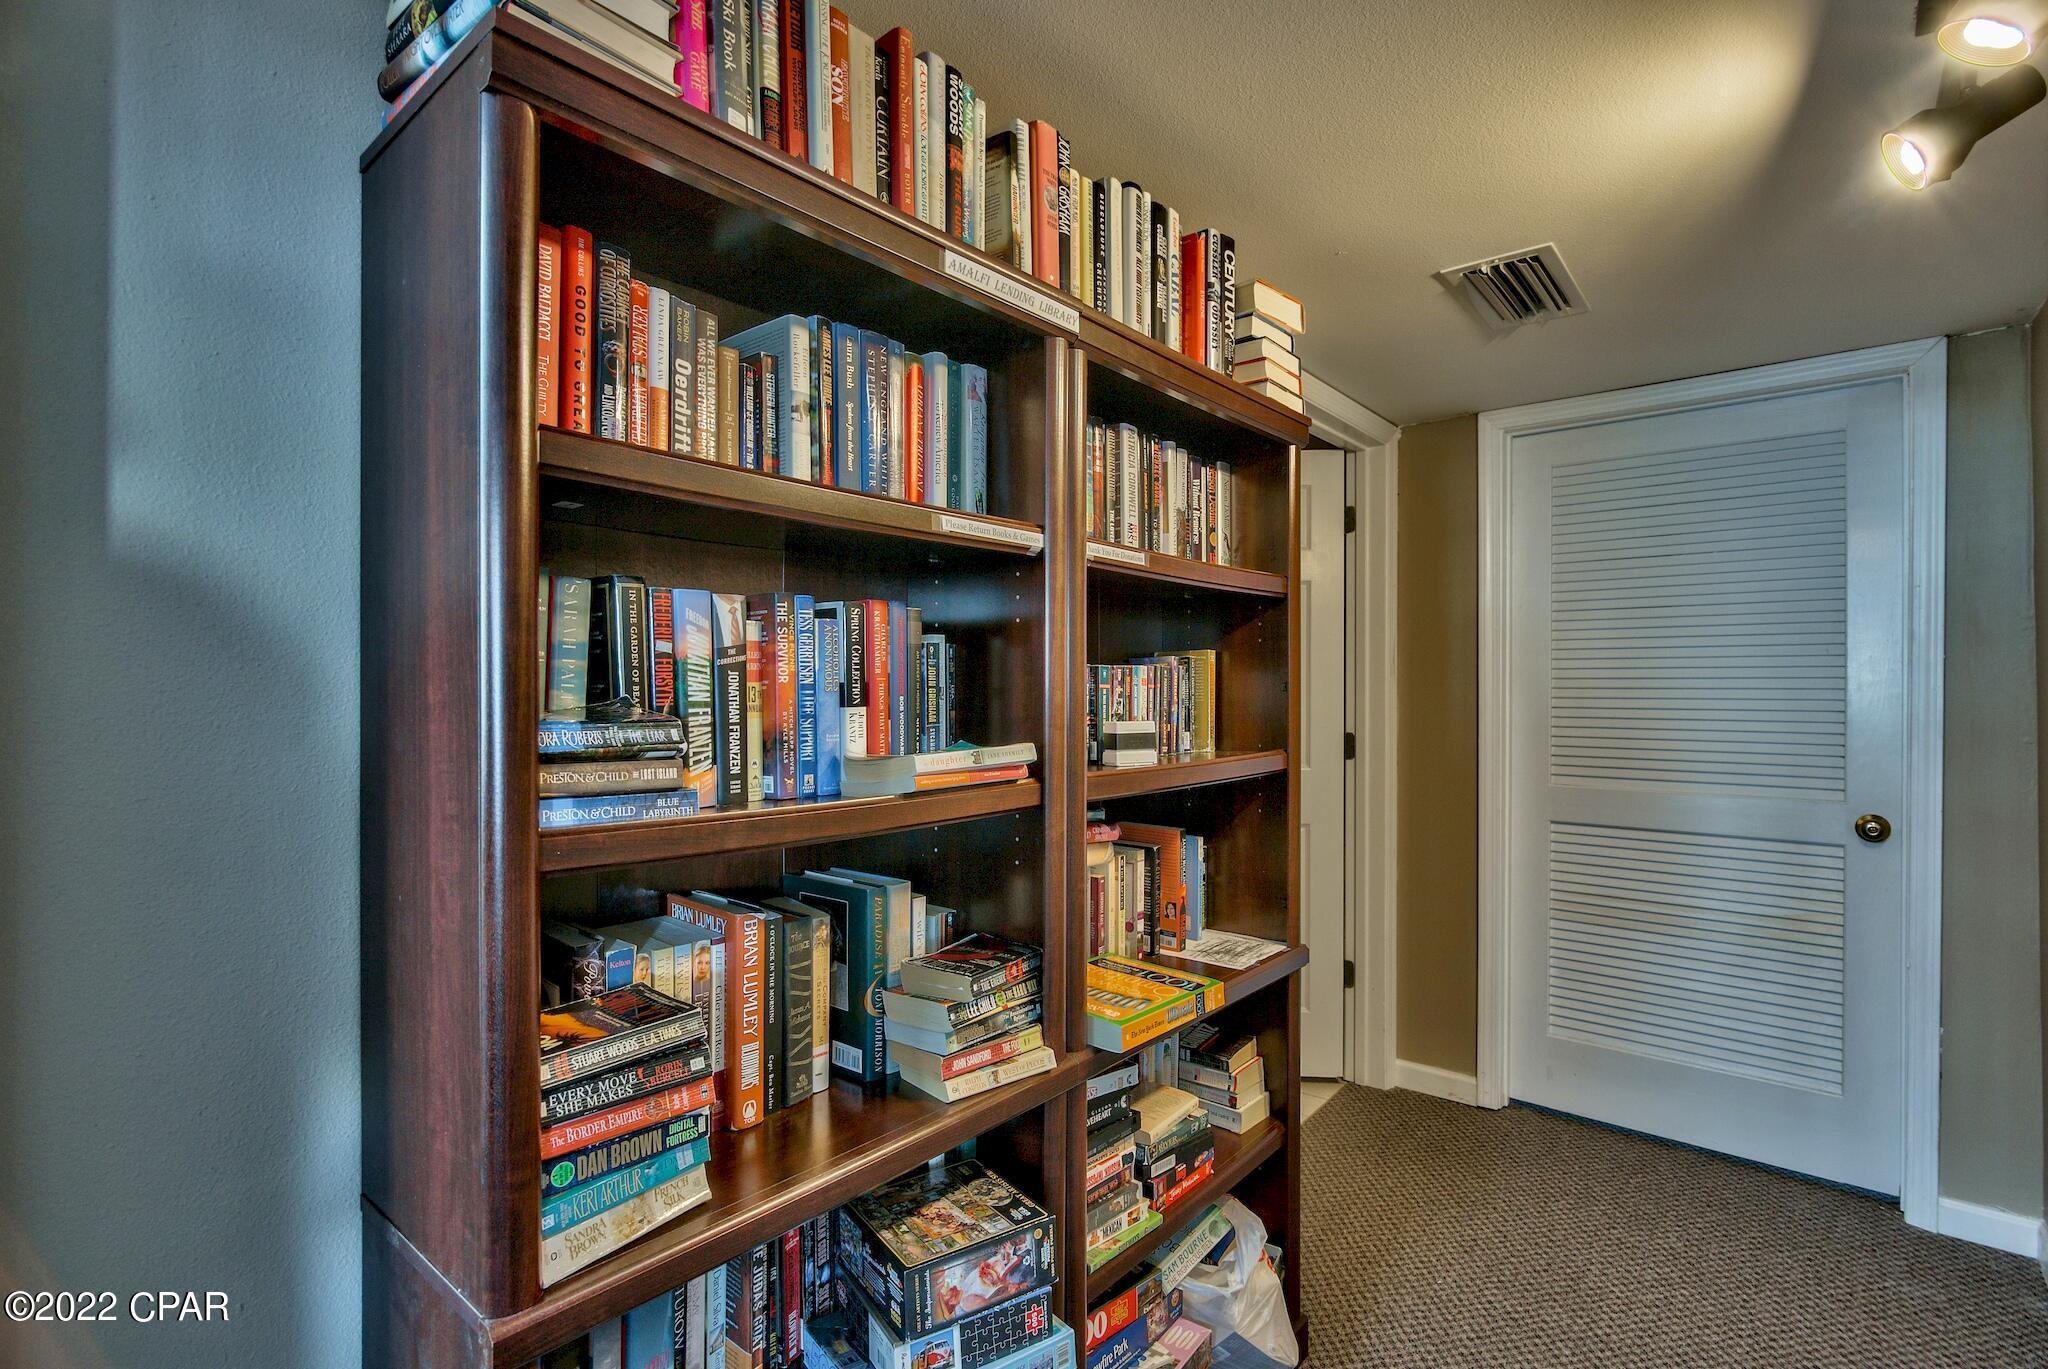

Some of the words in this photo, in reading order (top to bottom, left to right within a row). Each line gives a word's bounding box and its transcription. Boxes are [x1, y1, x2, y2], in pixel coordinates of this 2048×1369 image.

[722, 0, 735, 24] Ski
[723, 27, 736, 72] Book
[900, 35, 910, 90] Eminently
[690, 51, 702, 92] GAME
[832, 64, 844, 107] SON
[875, 56, 883, 81] Korda
[901, 93, 911, 138] Suitable
[949, 74, 958, 136] WOODS
[876, 95, 890, 182] CURTAIN
[1059, 136, 1069, 169] JOHN
[1059, 186, 1070, 235] GRISHAM
[577, 249, 585, 277] COLLINS
[948, 258, 991, 287] AMALFI
[994, 279, 1035, 308] LENDING
[1038, 300, 1079, 327] LIBRARY
[1224, 250, 1235, 341] CENTURY
[822, 326, 832, 358] JAMES
[1211, 305, 1219, 352] ODYSSEY
[538, 355, 550, 376] THE
[793, 334, 802, 388] Rockefeller
[823, 359, 832, 376] LEE
[846, 336, 854, 362] Laura
[767, 373, 776, 407] STEPHEN
[823, 376, 832, 406] BURKE
[846, 365, 854, 389] Bush
[538, 377, 549, 417] GUILTY
[674, 358, 692, 452] Oerdrift
[767, 408, 776, 438] HUNTER
[1128, 428, 1136, 469] PATRICIA
[880, 452, 888, 497] WHITE
[1128, 471, 1136, 520] CORNWELL
[1192, 478, 1200, 509] Without
[944, 518, 968, 533] Please
[968, 523, 991, 537] Return
[992, 527, 1013, 540] Books
[1012, 531, 1020, 541] &
[1019, 533, 1041, 546] Games
[1193, 510, 1201, 544] Remorse
[776, 601, 788, 622] THE
[798, 608, 813, 631] TESS
[851, 607, 861, 642] SPRING
[685, 625, 710, 703] JONATHAN
[777, 626, 788, 683] SURVIVOR
[798, 633, 814, 685] GERRITSEN
[823, 624, 832, 692] ANONYMOUS
[851, 645, 862, 705] COLLECTION
[727, 670, 741, 723] JONATHAN
[800, 690, 814, 715] LIFE
[687, 707, 712, 777] FRANZEN
[800, 718, 815, 762] SUPPORT
[849, 712, 858, 744] KRANTZ
[728, 725, 741, 774] FRANZEN
[542, 808, 589, 823] PRESTON
[590, 807, 602, 821] &
[602, 805, 636, 818] CHILD
[643, 806, 694, 819] LABYRINTH
[657, 797, 679, 807] BLUE
[671, 902, 695, 923] BRIAN
[695, 909, 728, 935] LUMLEY
[743, 918, 758, 969] BRIAN
[609, 957, 632, 970] Kelton
[743, 971, 759, 1036] LUMLEY
[967, 1002, 980, 1020] LEE
[979, 996, 996, 1016] CHILD
[874, 1017, 884, 1073] MORRISON
[951, 1057, 968, 1072] JOHN
[967, 1049, 992, 1068] SANDFORD
[654, 1058, 684, 1075] ROBIN
[741, 1041, 760, 1091] BLOODWARS
[549, 1081, 595, 1108] EVERY
[597, 1071, 638, 1092] MOVE
[556, 1099, 584, 1118] SHE
[587, 1085, 634, 1110] MAKES
[550, 1133, 565, 1150] The
[566, 1116, 607, 1143] BORDER
[607, 1105, 644, 1130] EMPIRE
[666, 1126, 699, 1148] FORTRESS
[668, 1116, 695, 1134] DIGITAL
[576, 1146, 608, 1182] DAN
[610, 1129, 663, 1171] BROWN
[572, 1190, 601, 1223] KERI
[600, 1167, 644, 1210] ARTHUR
[653, 1176, 689, 1204] FRENCH
[663, 1191, 686, 1209] SILK
[564, 1217, 608, 1245] SANDRA
[569, 1230, 607, 1261] BROWN
[1163, 1263, 1179, 1281] SAM
[1178, 1229, 1209, 1266] BOURNE
[1167, 1274, 1179, 1287] THE
[1176, 1248, 1205, 1278] RIGHTEOUS
[1203, 1239, 1215, 1253] MEN
[712, 1268, 721, 1302] Daniel
[753, 1265, 763, 1312] JUDAS
[674, 1284, 684, 1349] TUROW
[712, 1302, 721, 1327] Silva
[924, 1318, 932, 1330] The
[752, 1316, 762, 1353] GOAT
[1113, 1337, 1130, 1356] Park
